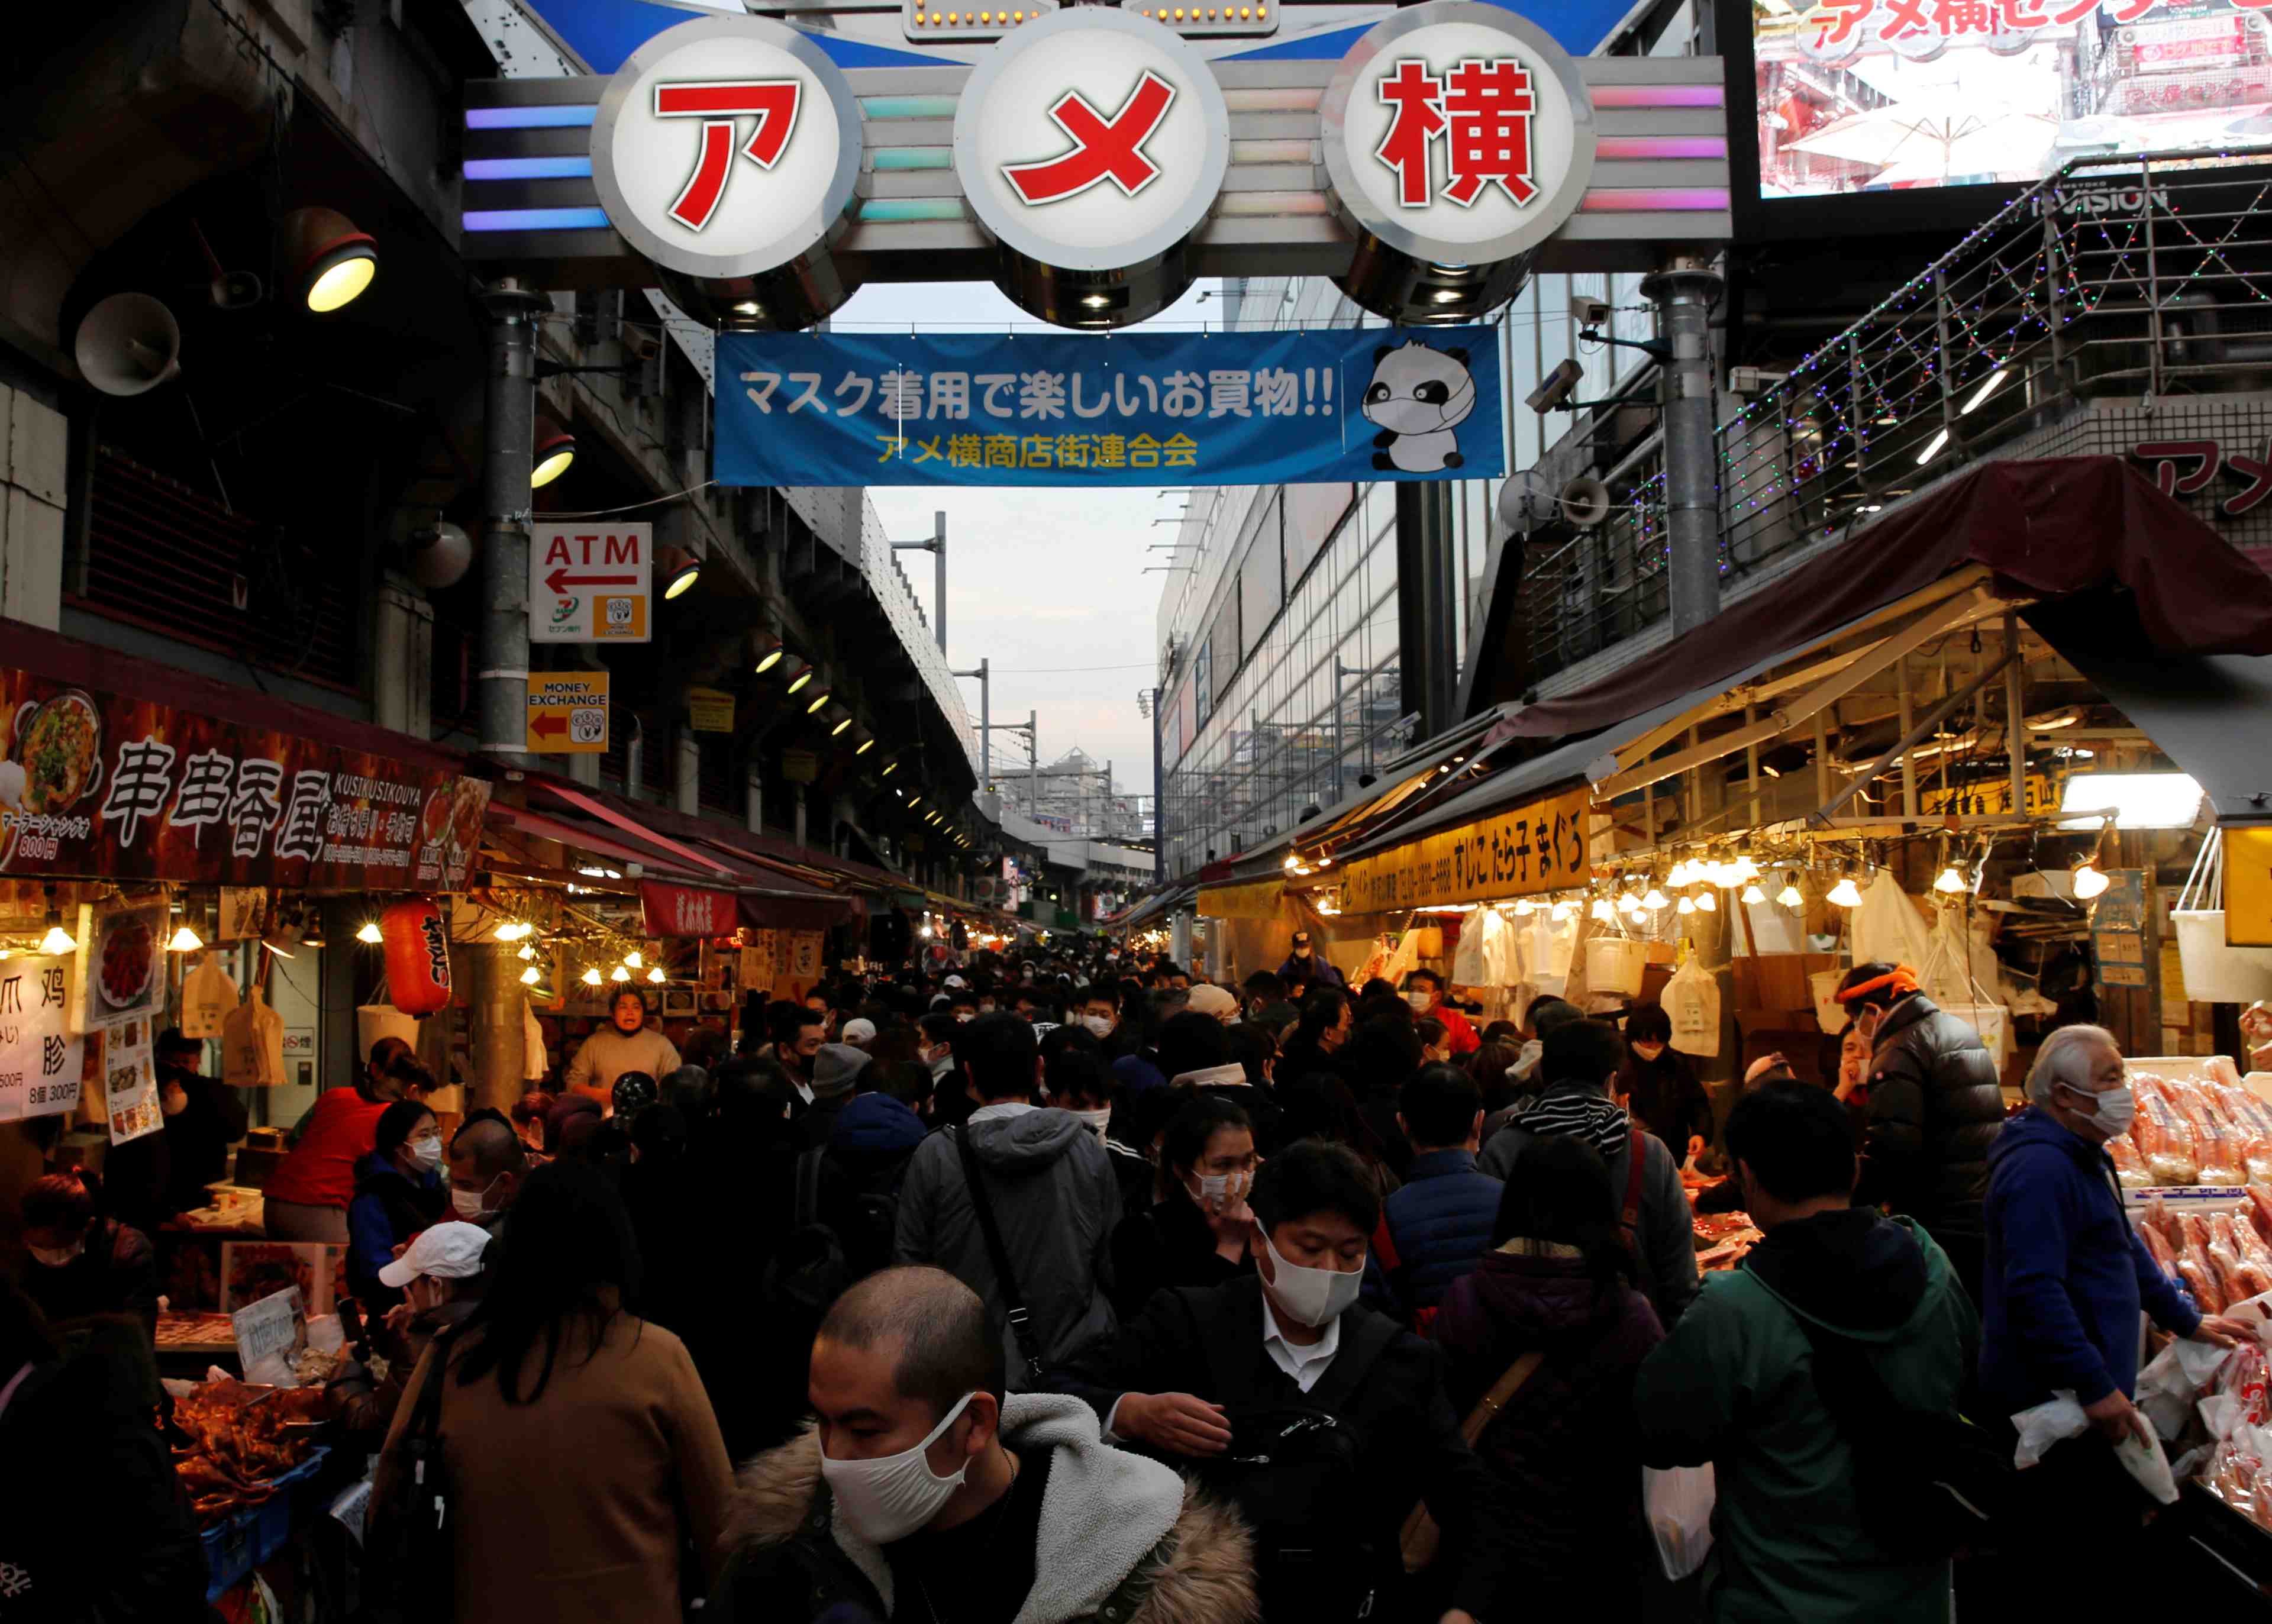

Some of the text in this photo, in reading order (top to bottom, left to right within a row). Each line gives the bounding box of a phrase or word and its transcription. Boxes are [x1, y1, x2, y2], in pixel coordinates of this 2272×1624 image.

[1821, 0, 2272, 44] アメ横セ
[740, 367, 1334, 420] マスク着用で楽しいお買物!!
[876, 432, 1198, 469] アメ横商店街連合会
[545, 535, 639, 565] ATM
[529, 695, 606, 706] EXCHANGE
[545, 683, 590, 693] MONEY
[334, 773, 421, 807] KUSIKUSIKOUYA
[19, 835, 59, 861] 800円
[1455, 835, 1487, 890] すじこ
[1492, 819, 1531, 883] たら子
[1535, 809, 1583, 879] まぐろ
[50, 1082, 78, 1102] 300円
